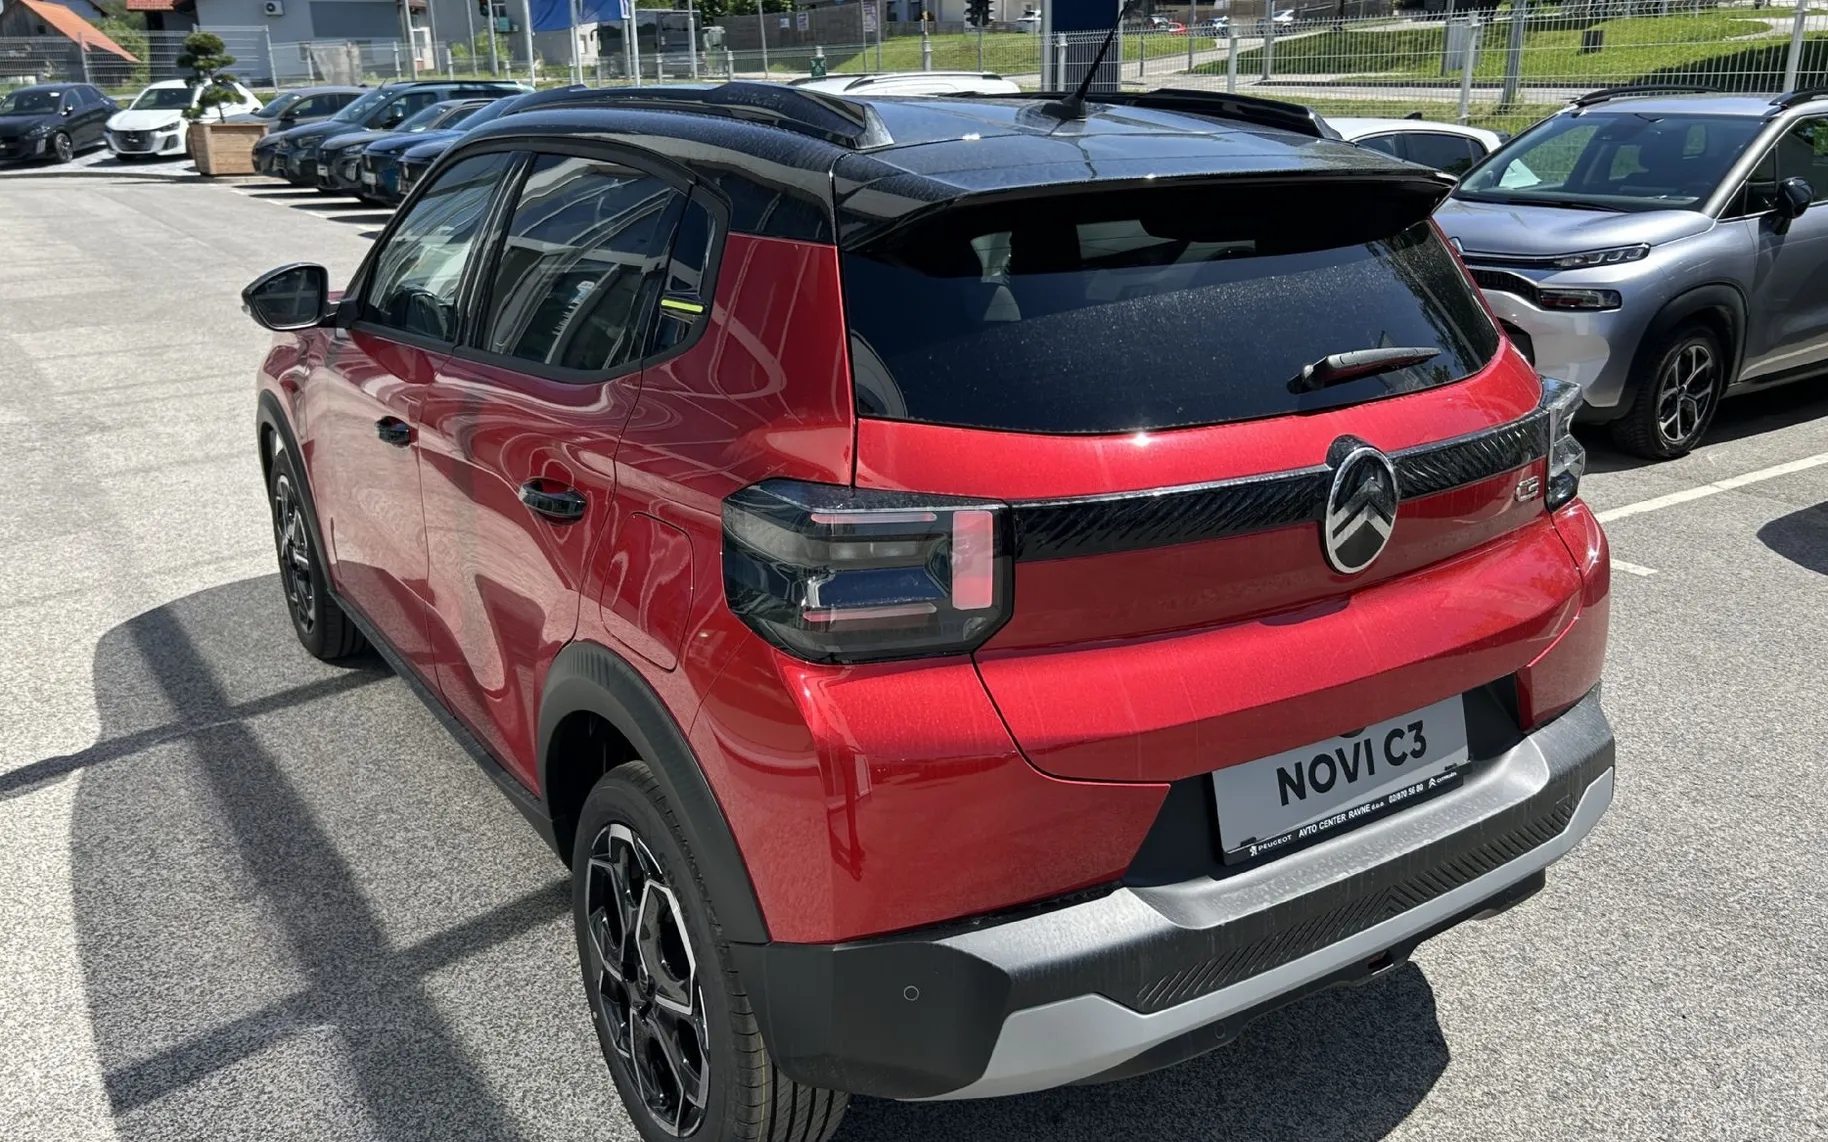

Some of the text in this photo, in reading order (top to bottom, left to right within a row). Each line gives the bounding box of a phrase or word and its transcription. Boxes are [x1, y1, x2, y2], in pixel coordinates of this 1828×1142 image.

[1276, 720, 1427, 806] NOVI C3
[1258, 834, 1293, 851] PEUGEOT
[1298, 824, 1318, 838] AVTO
[1318, 813, 1347, 830] CENTER
[1348, 803, 1371, 819] RAVNE
